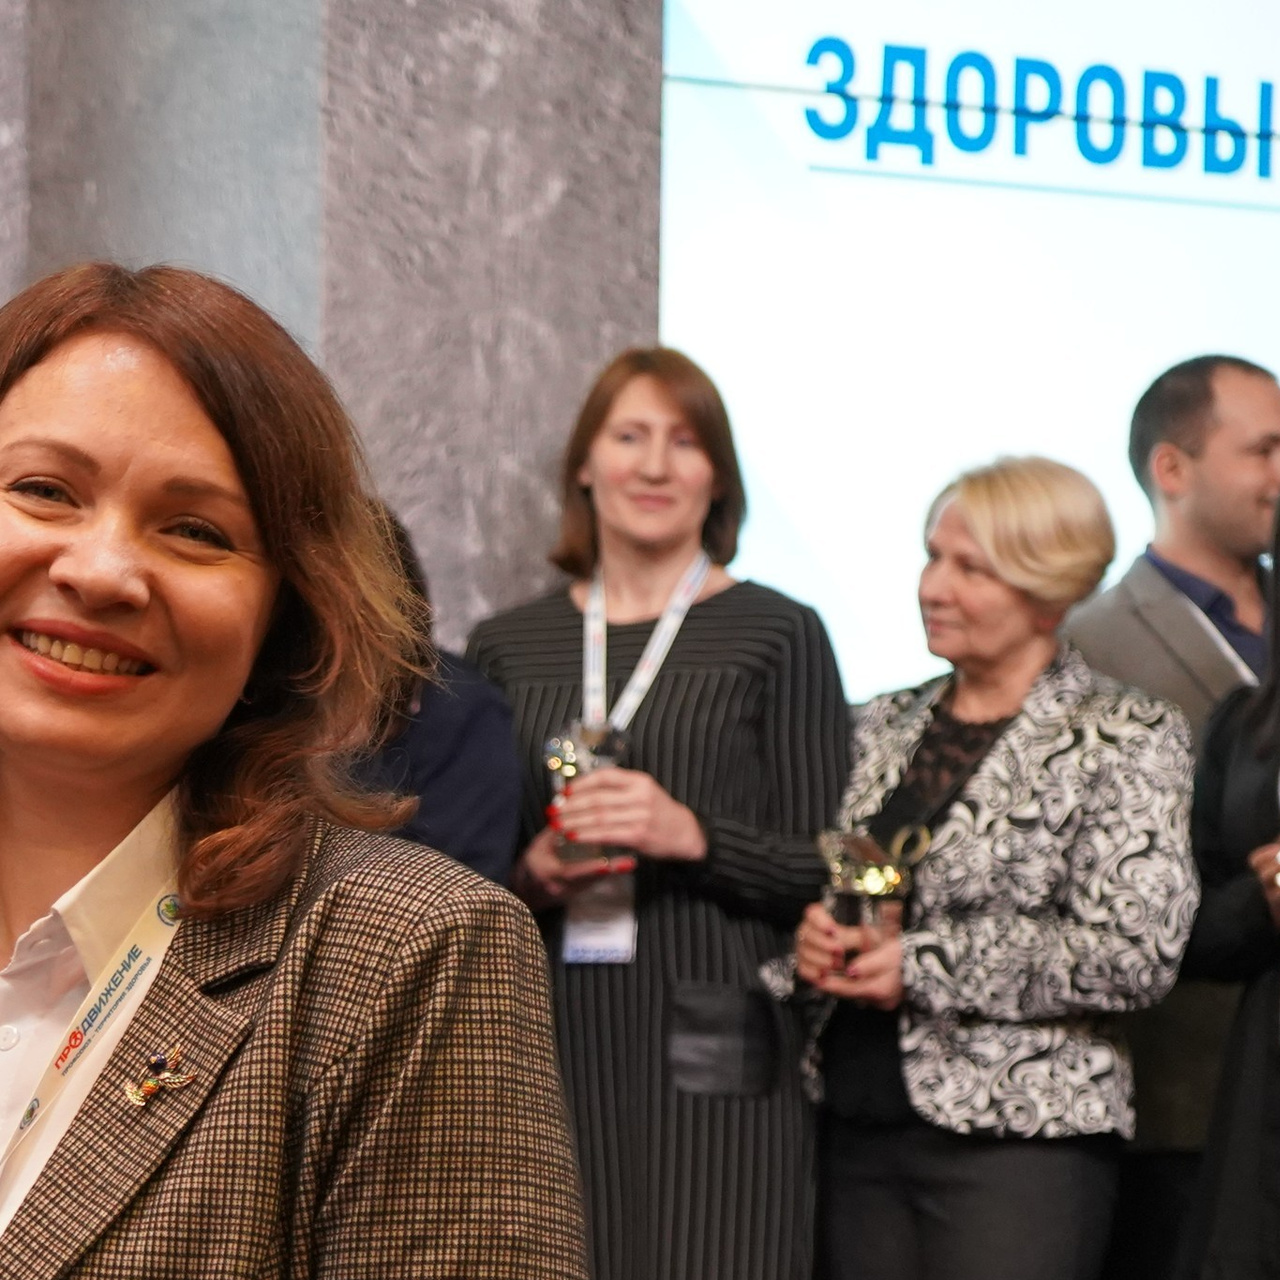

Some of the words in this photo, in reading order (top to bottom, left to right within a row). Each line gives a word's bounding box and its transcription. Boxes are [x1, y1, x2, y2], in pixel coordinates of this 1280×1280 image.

[805, 36, 1274, 179] ЗДОРОВЫ
[94, 991, 127, 1034] ТЕРРИТОРИЯ
[125, 956, 153, 993] ЗДОРОВЬЯ
